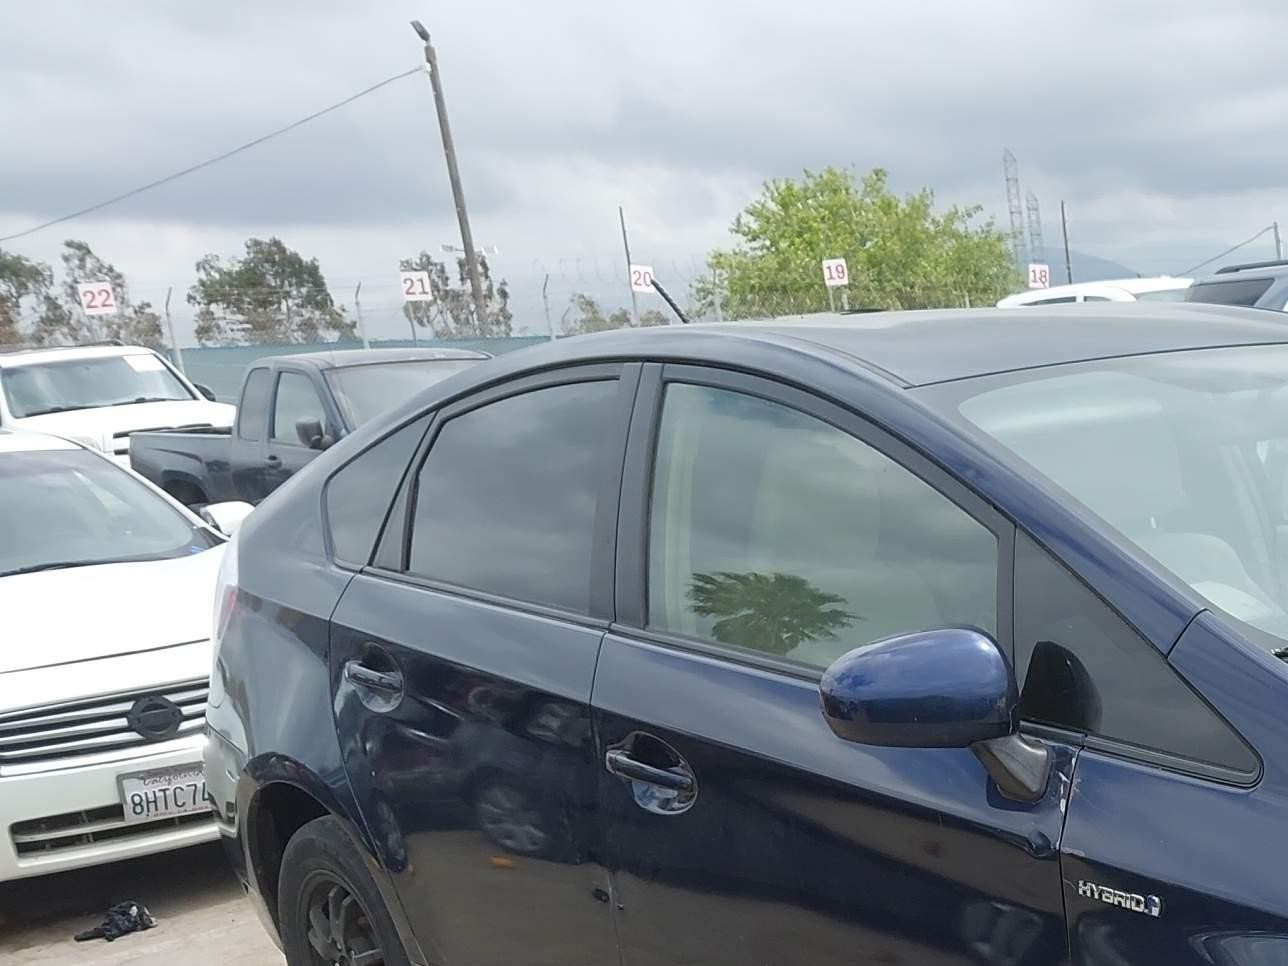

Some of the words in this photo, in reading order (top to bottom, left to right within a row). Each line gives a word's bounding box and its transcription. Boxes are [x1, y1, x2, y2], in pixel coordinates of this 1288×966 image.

[633, 270, 652, 287] 20
[826, 264, 845, 280] 19
[1031, 269, 1047, 284] 18
[403, 277, 429, 295] 21
[82, 288, 113, 309] 22
[1078, 879, 1145, 913] HYBRID
